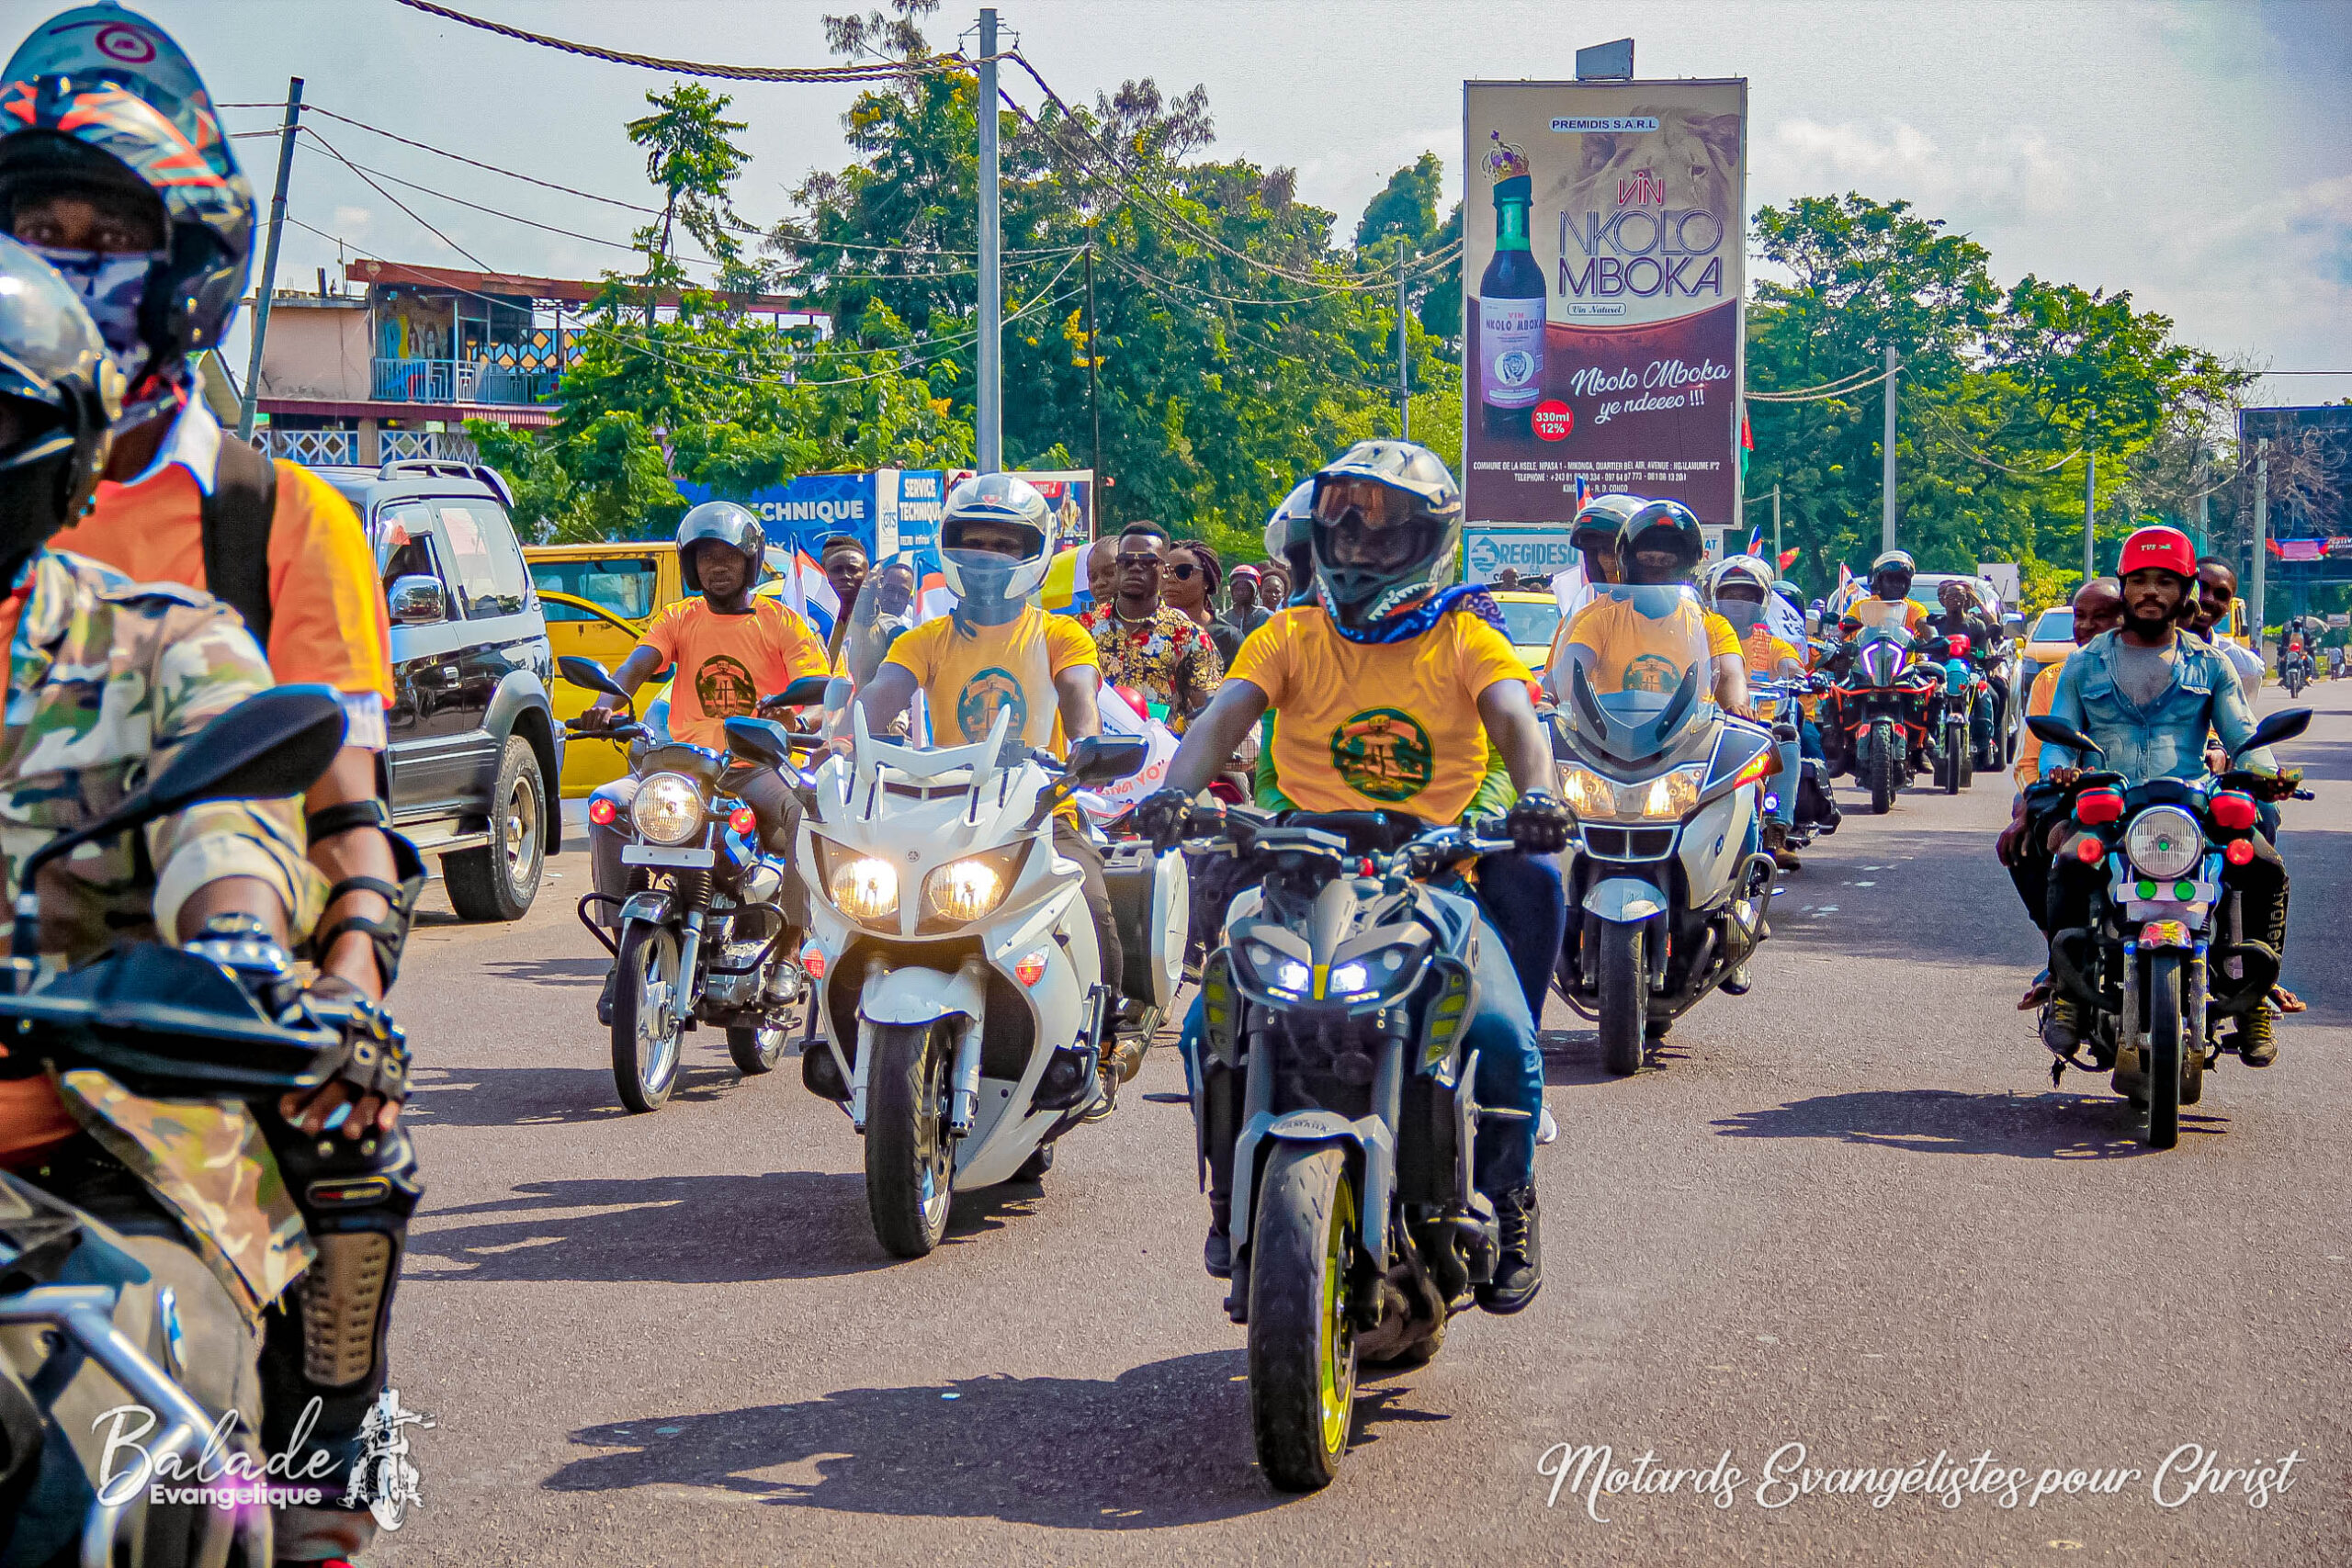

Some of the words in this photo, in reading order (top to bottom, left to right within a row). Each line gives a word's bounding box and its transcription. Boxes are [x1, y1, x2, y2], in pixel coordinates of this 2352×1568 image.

[1552, 119, 1610, 130] PREMIDIS
[1613, 119, 1657, 130] S.A.R.L
[1618, 172, 1664, 206] VIN
[1558, 209, 1723, 255] NKOLO
[1558, 256, 1724, 297] MBOKA
[1572, 305, 1587, 313] Vin
[1570, 367, 1638, 398] Nkolo
[1643, 358, 1732, 389] Mboka
[1536, 412, 1570, 423] 330ml
[1595, 400, 1623, 424] ye
[1623, 391, 1685, 413] ndeeeo
[1541, 423, 1566, 434] 12%
[1473, 461, 1501, 470] COMMUNE
[1502, 461, 1510, 470] DE
[1511, 461, 1519, 470] LA
[1596, 461, 1623, 470] QUARTIER
[1624, 461, 1634, 470] BEL
[1647, 461, 1669, 470] AVENUE
[1514, 473, 1545, 482] TELEPHONE
[904, 478, 936, 498] SERVICE
[1498, 543, 1579, 565] REGIDESO
